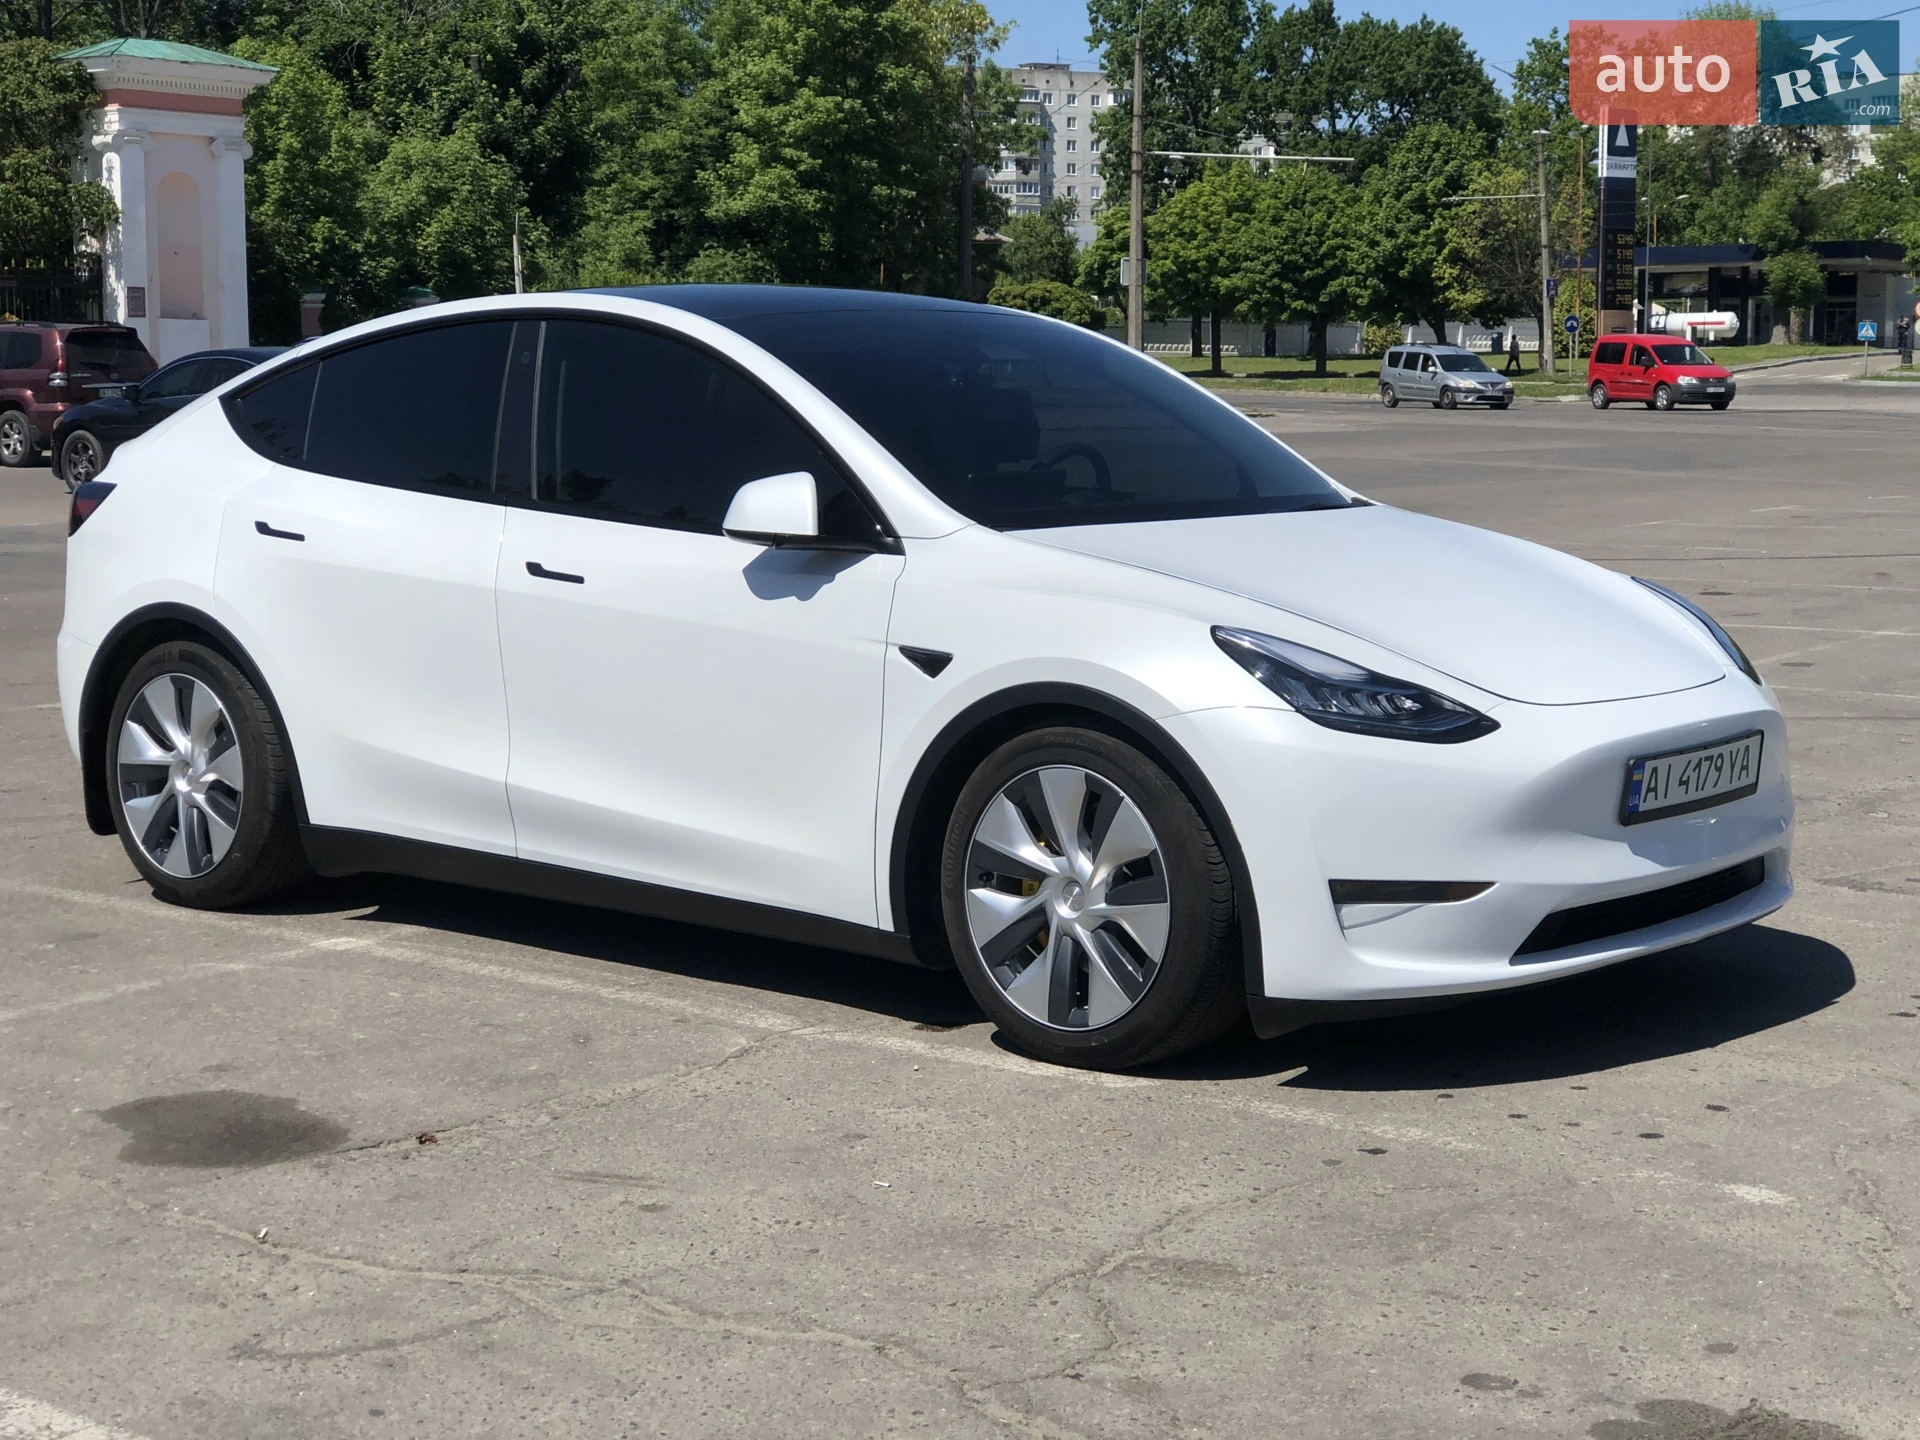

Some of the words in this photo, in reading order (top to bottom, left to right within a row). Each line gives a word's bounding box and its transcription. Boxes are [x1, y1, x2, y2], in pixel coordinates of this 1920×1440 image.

[1643, 763, 1671, 803] AI
[1677, 752, 1724, 795] 4179
[1728, 745, 1750, 785] YA
[1629, 795, 1640, 806] UA
